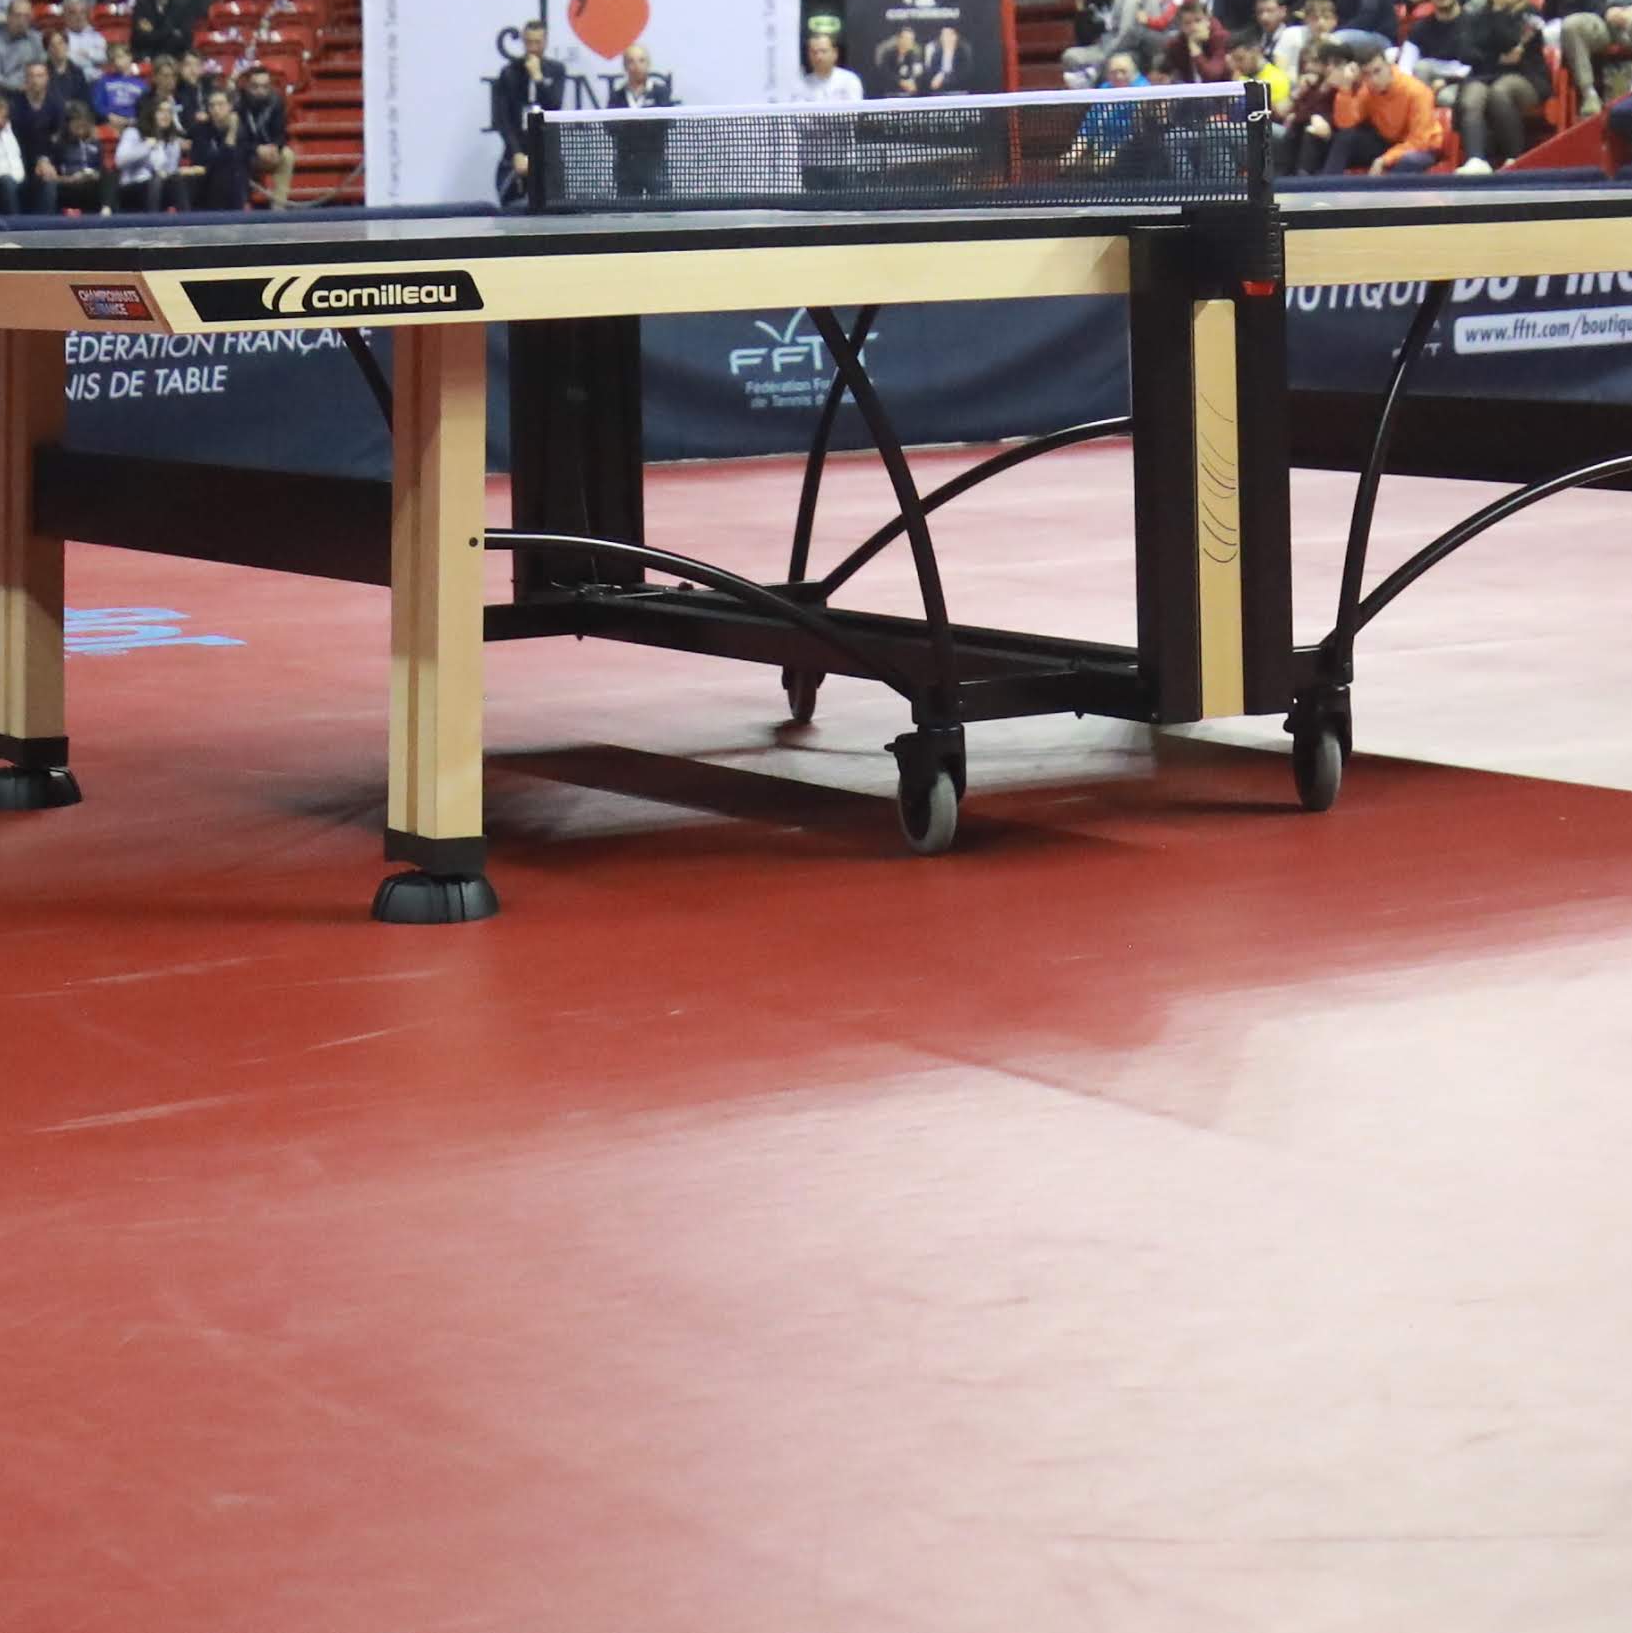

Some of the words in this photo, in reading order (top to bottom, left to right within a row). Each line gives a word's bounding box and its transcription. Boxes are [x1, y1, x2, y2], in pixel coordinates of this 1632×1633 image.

[311, 282, 457, 309] cornilleau
[65, 329, 215, 365] ÉDÉRATION
[729, 332, 880, 375] FFT
[110, 370, 144, 399] DE
[155, 365, 228, 395] TABLE
